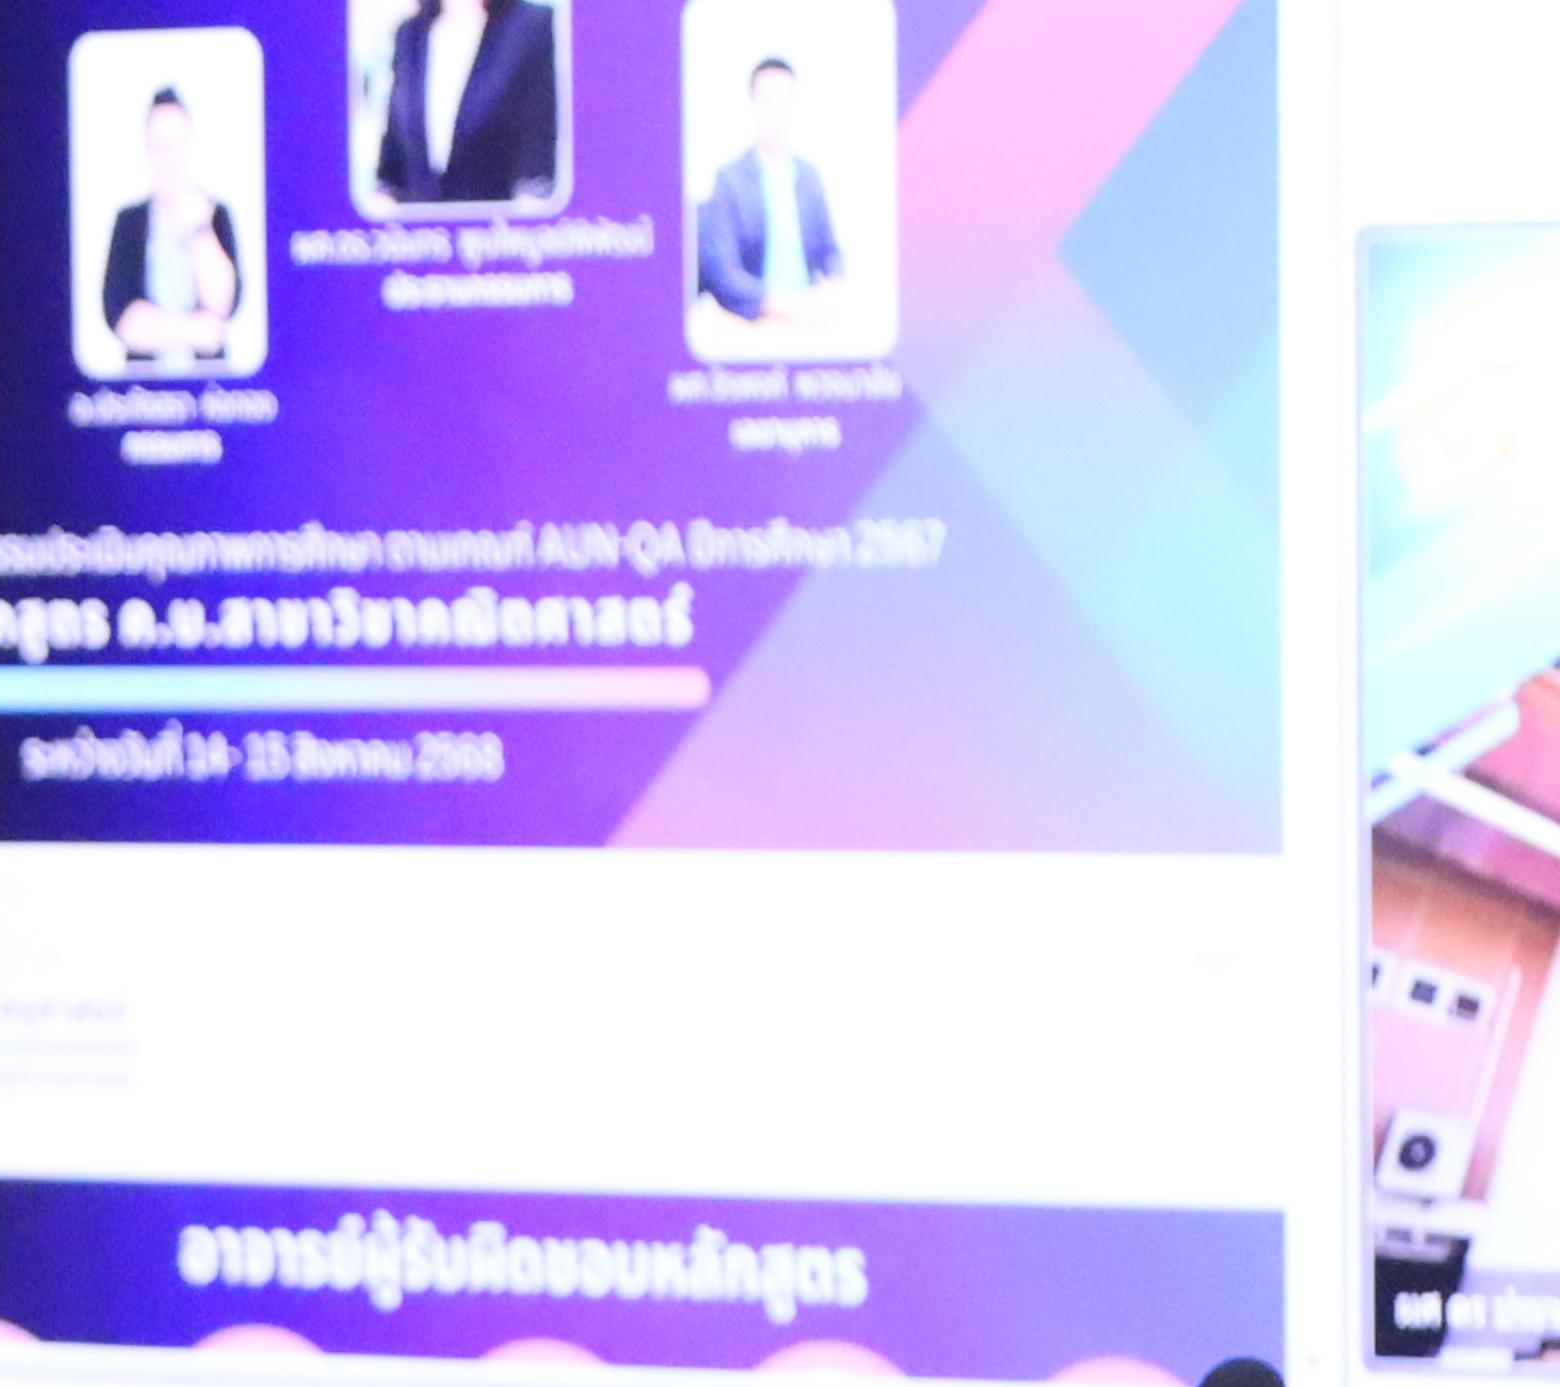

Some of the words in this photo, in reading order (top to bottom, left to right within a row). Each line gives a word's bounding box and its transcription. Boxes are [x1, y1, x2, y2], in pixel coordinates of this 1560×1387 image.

[536, 519, 686, 578] AUN-QA
[177, 1207, 870, 1323] อาจารย์ผู้รับผิดชอบหลักสูตร
